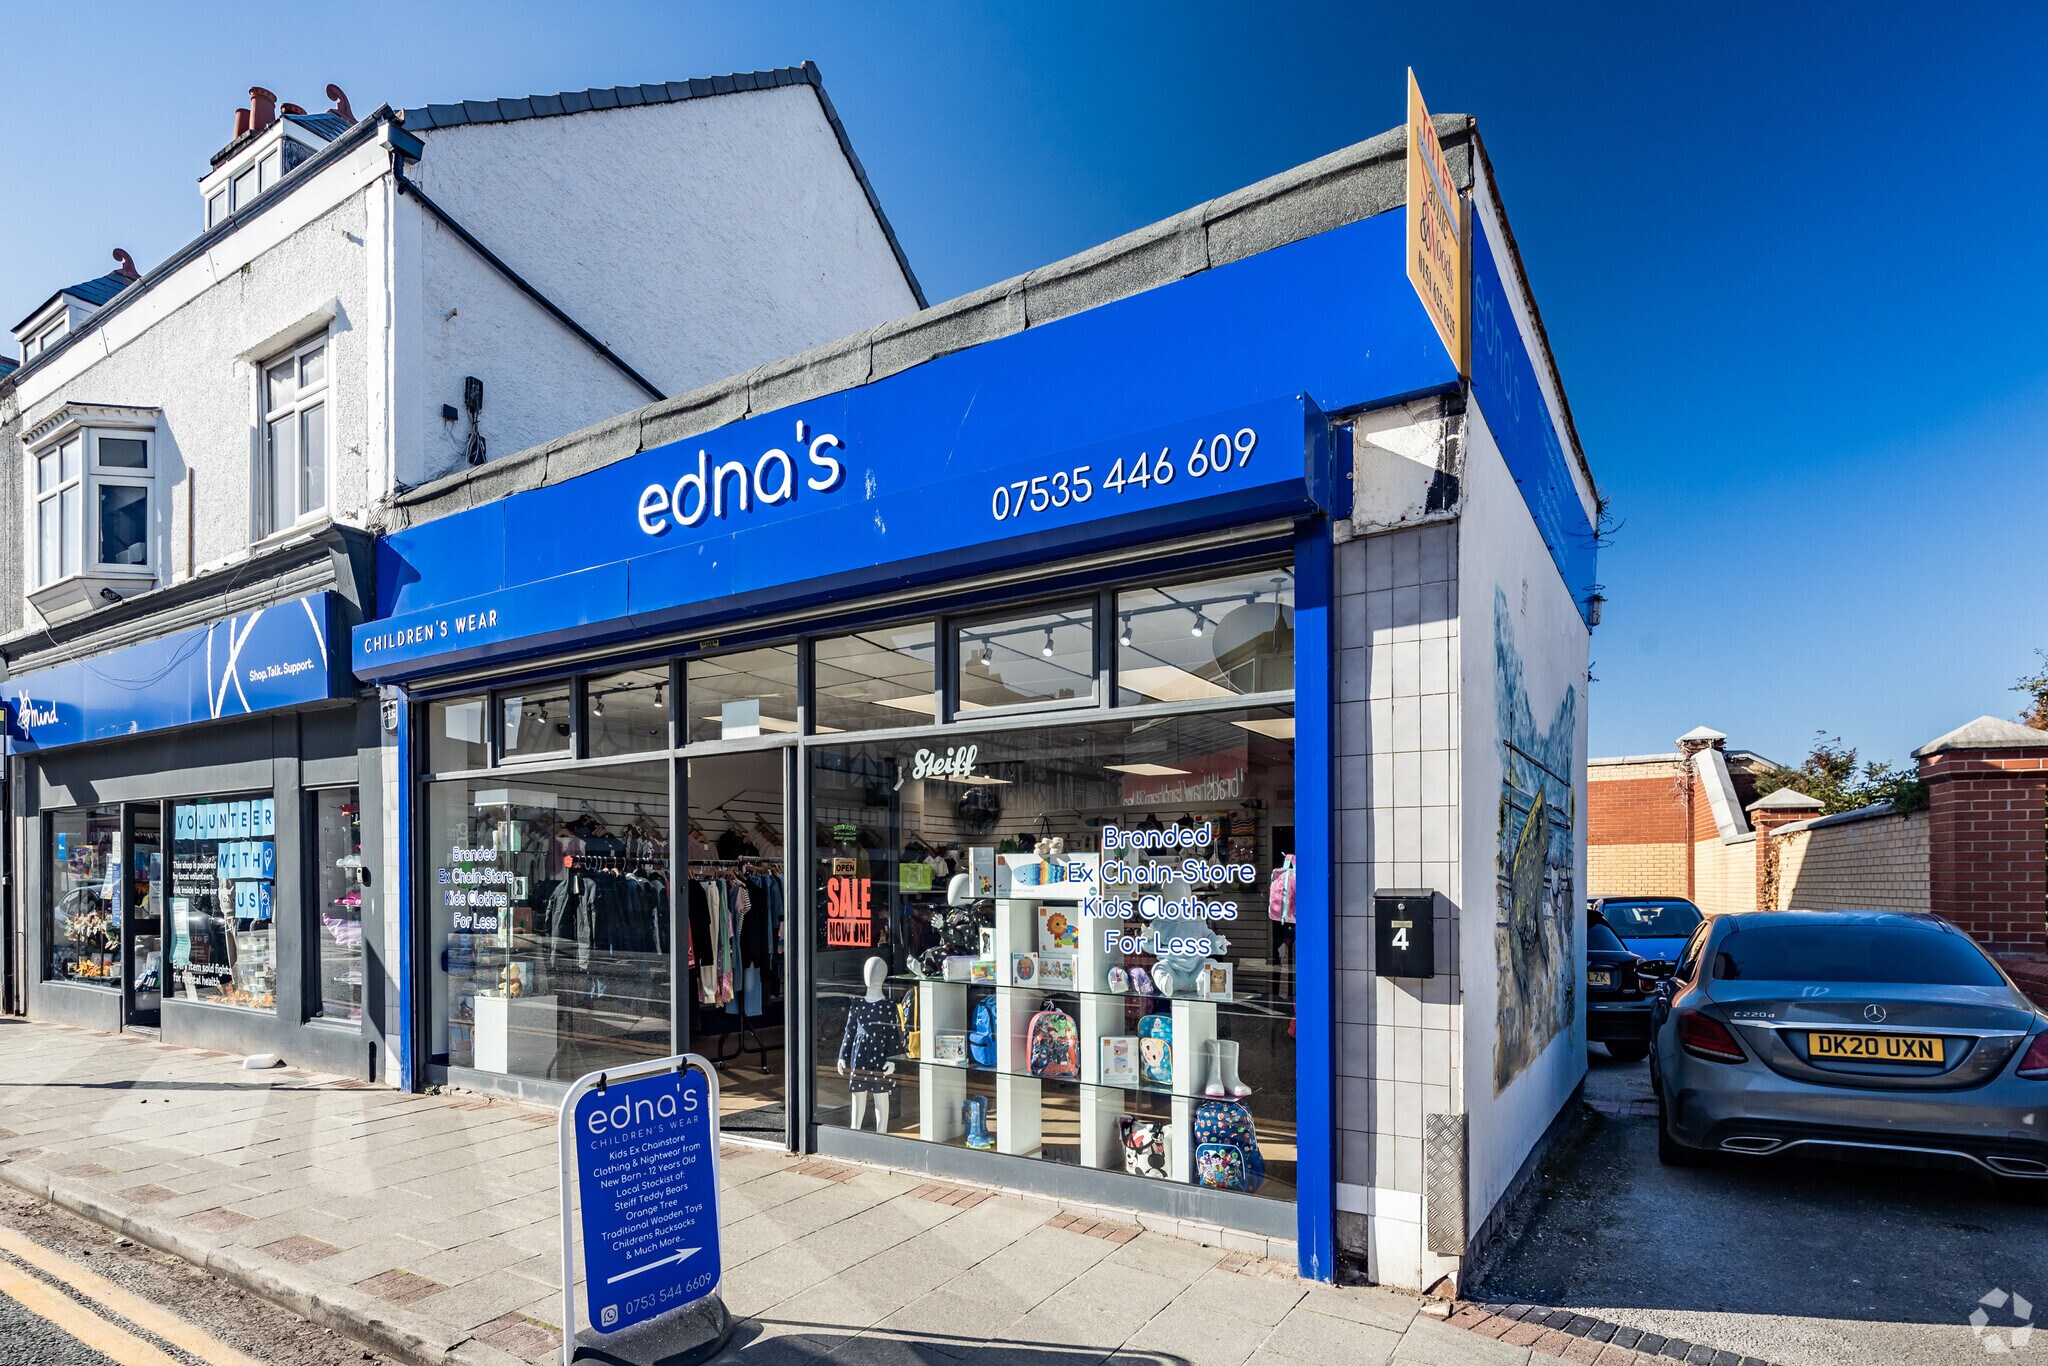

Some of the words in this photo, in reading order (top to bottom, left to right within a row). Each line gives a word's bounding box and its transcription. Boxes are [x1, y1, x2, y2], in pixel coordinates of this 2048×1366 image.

[1418, 249, 1431, 292] 0151
[638, 420, 841, 536] edna's
[992, 465, 1093, 522] 07535
[1102, 447, 1175, 494] 446
[1187, 427, 1258, 477] 609
[364, 620, 449, 654] CHILDREN'S
[455, 610, 498, 634] WEAR
[31, 700, 59, 728] mind
[912, 744, 978, 780] Steiff
[177, 809, 273, 830] VOLUNTEER
[1102, 823, 1212, 848] Branded
[172, 860, 182, 869] This
[182, 860, 193, 871] shop
[192, 860, 197, 869] is
[218, 852, 261, 869] WITH
[452, 845, 497, 862] Branded
[172, 872, 179, 881] by
[178, 872, 190, 880] local
[438, 868, 451, 884] Ex
[451, 867, 514, 884] Chain-Store
[836, 864, 855, 872] OPEN
[1067, 861, 1094, 884] Ex
[1101, 860, 1256, 884] Chain-Store
[181, 886, 194, 894] inside
[194, 886, 200, 894] to
[237, 892, 256, 908] US
[445, 890, 466, 907] Kids
[467, 890, 507, 907] Clothes
[827, 877, 871, 919] SALE
[1082, 896, 1133, 919] Kids
[1138, 896, 1238, 920] Clothes
[453, 912, 472, 928] For
[473, 912, 497, 930] Less
[829, 922, 851, 943] NOW
[853, 922, 869, 944] ON!
[1104, 931, 1148, 954] For
[1154, 932, 1213, 957] Less
[1391, 927, 1410, 951] 4
[173, 971, 181, 982] for
[202, 962, 215, 973] sold
[214, 963, 232, 977] fights
[1819, 1035, 1879, 1056] DK20
[1886, 1038, 1934, 1059] UXN
[588, 1083, 698, 1134] edna's
[591, 1124, 664, 1150] CHILDREN'S
[669, 1115, 700, 1130] WEAR
[609, 1149, 628, 1161] Kids
[629, 1145, 640, 1156] Ex
[641, 1134, 686, 1152] Chainstore
[593, 1162, 631, 1178] Clothing
[632, 1158, 639, 1168] &
[640, 1148, 681, 1165] Nightwear
[682, 1142, 701, 1153] from
[600, 1177, 620, 1189] New
[621, 1171, 642, 1184] Born
[648, 1165, 657, 1176] 12
[657, 1161, 681, 1172] Years
[681, 1154, 697, 1166] Old
[616, 1184, 640, 1198] Local
[641, 1175, 675, 1191] Stockist
[675, 1170, 685, 1180] of:
[614, 1196, 638, 1212] Steiff
[638, 1190, 665, 1204] Teddy
[665, 1183, 689, 1196] Bears
[625, 1205, 659, 1221] Orange
[659, 1198, 678, 1210] Tree
[601, 1220, 649, 1242] Traditional
[650, 1209, 684, 1226] Wooden
[684, 1203, 703, 1214] Toys
[612, 1231, 653, 1251] Childrens
[654, 1217, 696, 1237] Rucksacks
[625, 1251, 633, 1260] &
[634, 1243, 658, 1257] Much
[625, 1293, 656, 1315] 0753
[659, 1283, 682, 1302] 544
[685, 1272, 712, 1293] 6609
